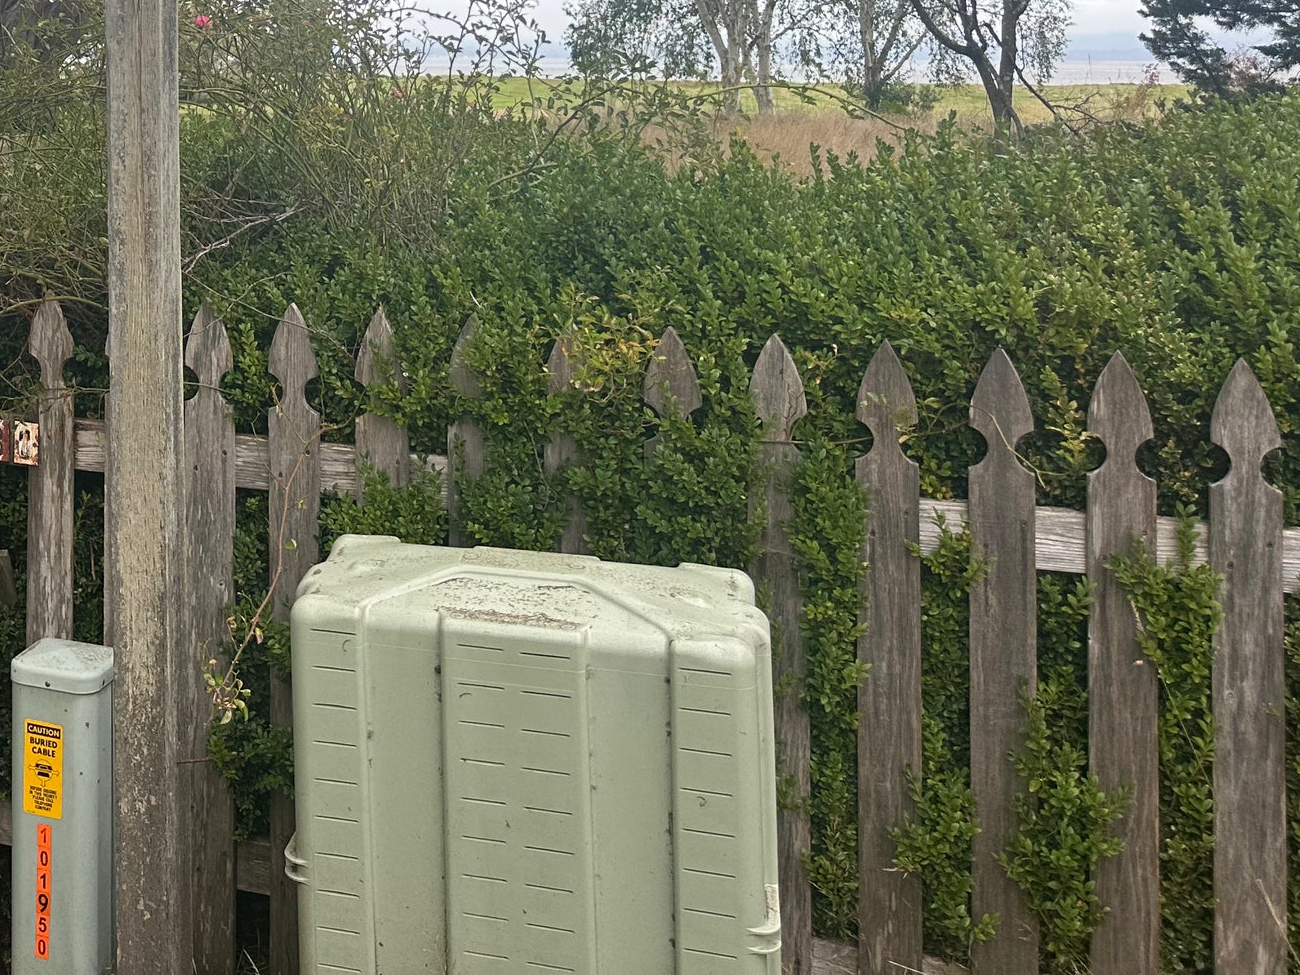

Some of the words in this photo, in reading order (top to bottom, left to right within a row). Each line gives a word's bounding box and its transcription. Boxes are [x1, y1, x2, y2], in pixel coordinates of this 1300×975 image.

[27, 724, 60, 738] CAUTION
[29, 736, 58, 749] BURIED
[31, 746, 56, 758] CABLE
[37, 827, 49, 956] 101950
